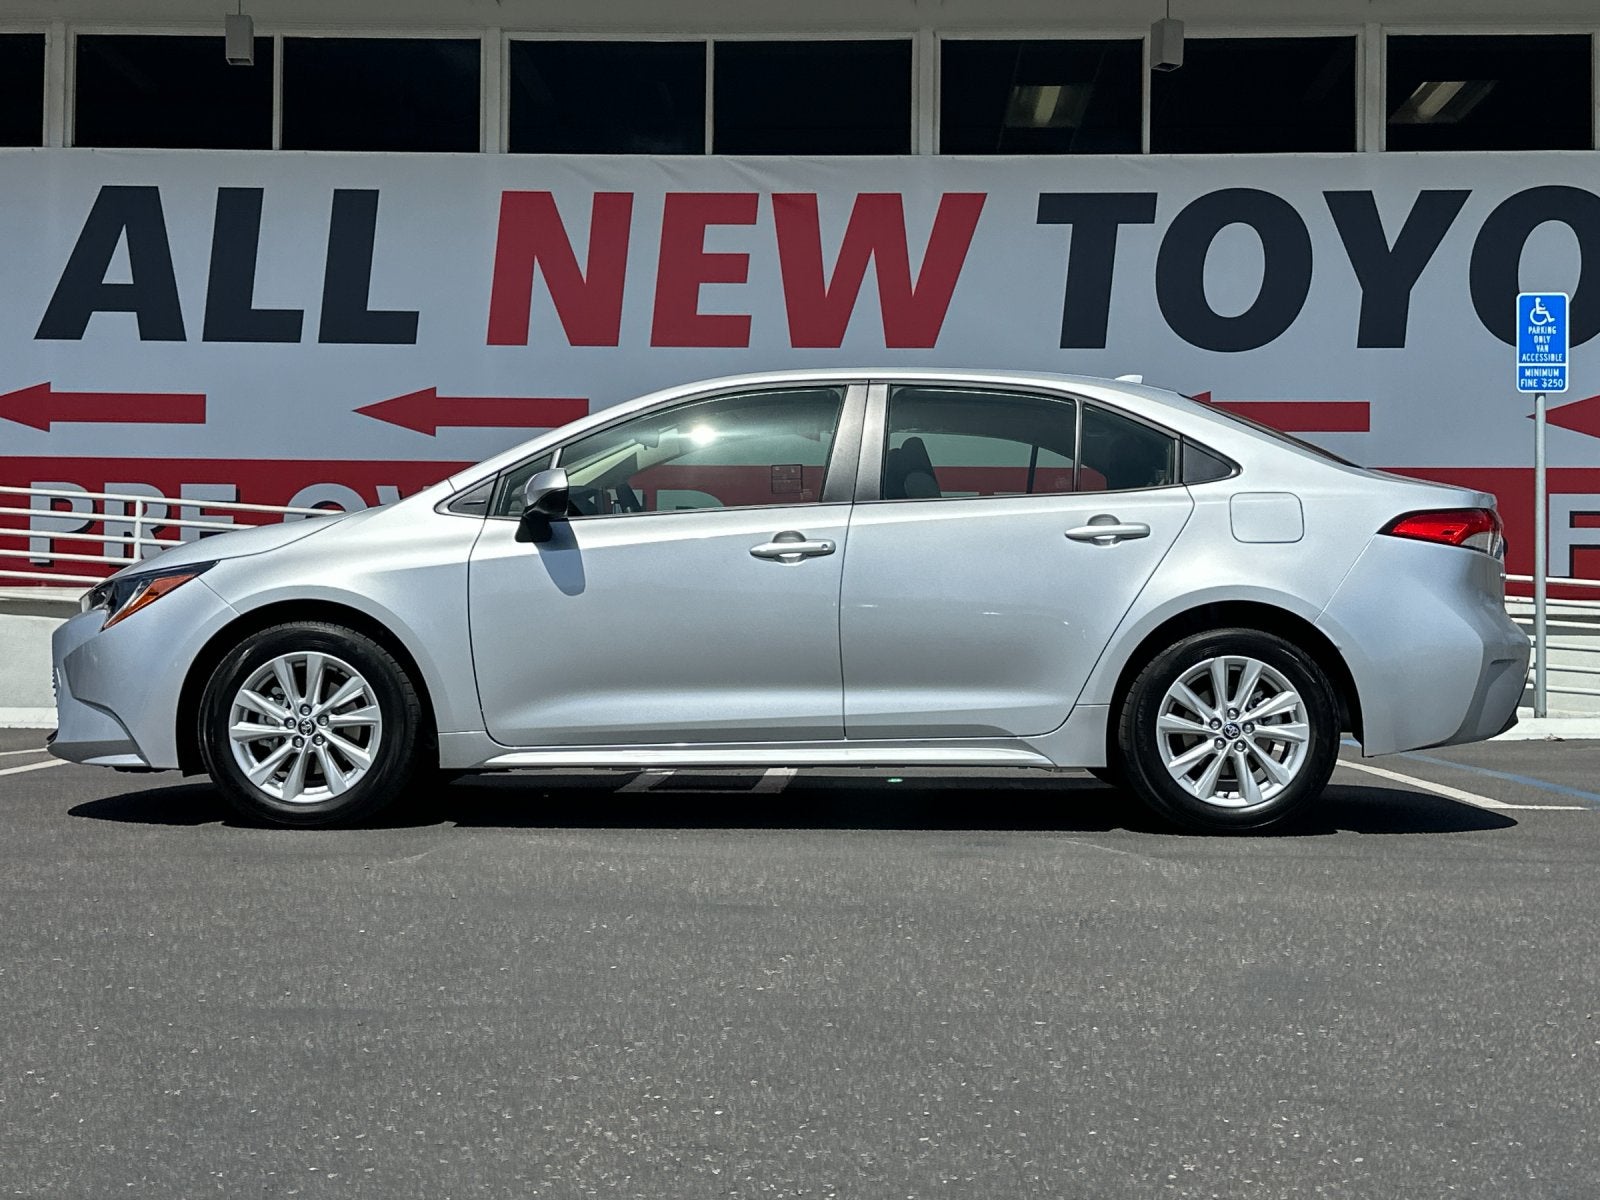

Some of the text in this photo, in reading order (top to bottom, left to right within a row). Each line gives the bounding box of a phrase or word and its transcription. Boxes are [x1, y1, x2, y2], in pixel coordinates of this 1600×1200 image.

[35, 185, 1600, 353] ALL NEW TOYO
[1528, 326, 1557, 334] PARKING
[1533, 335, 1551, 344] ONLY
[1536, 344, 1549, 352] VAN
[1522, 353, 1563, 362] ACCESSIBLE
[1525, 368, 1559, 377] MINIMUM
[1520, 377, 1563, 389] FINE $250
